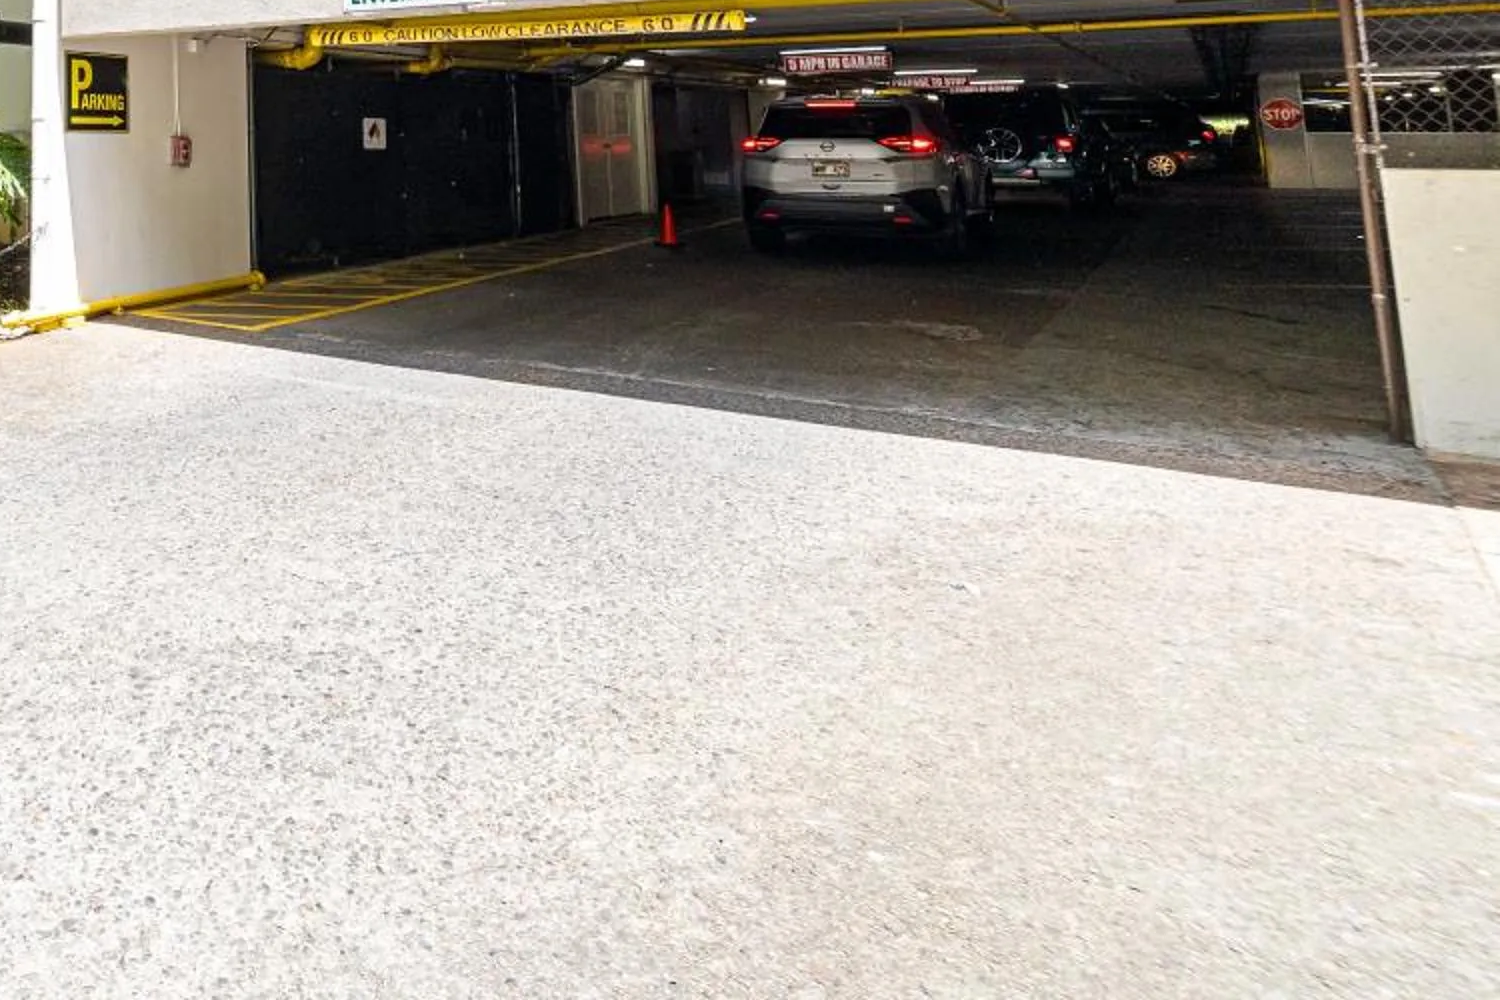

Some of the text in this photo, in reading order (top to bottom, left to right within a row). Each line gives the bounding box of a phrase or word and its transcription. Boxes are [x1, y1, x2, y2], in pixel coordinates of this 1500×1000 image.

[383, 25, 459, 41] CAUTION
[462, 24, 502, 39] LOW
[505, 18, 626, 37] CLEARANCE
[842, 55, 889, 69] GARAGE
[1262, 108, 1301, 121] STOP
